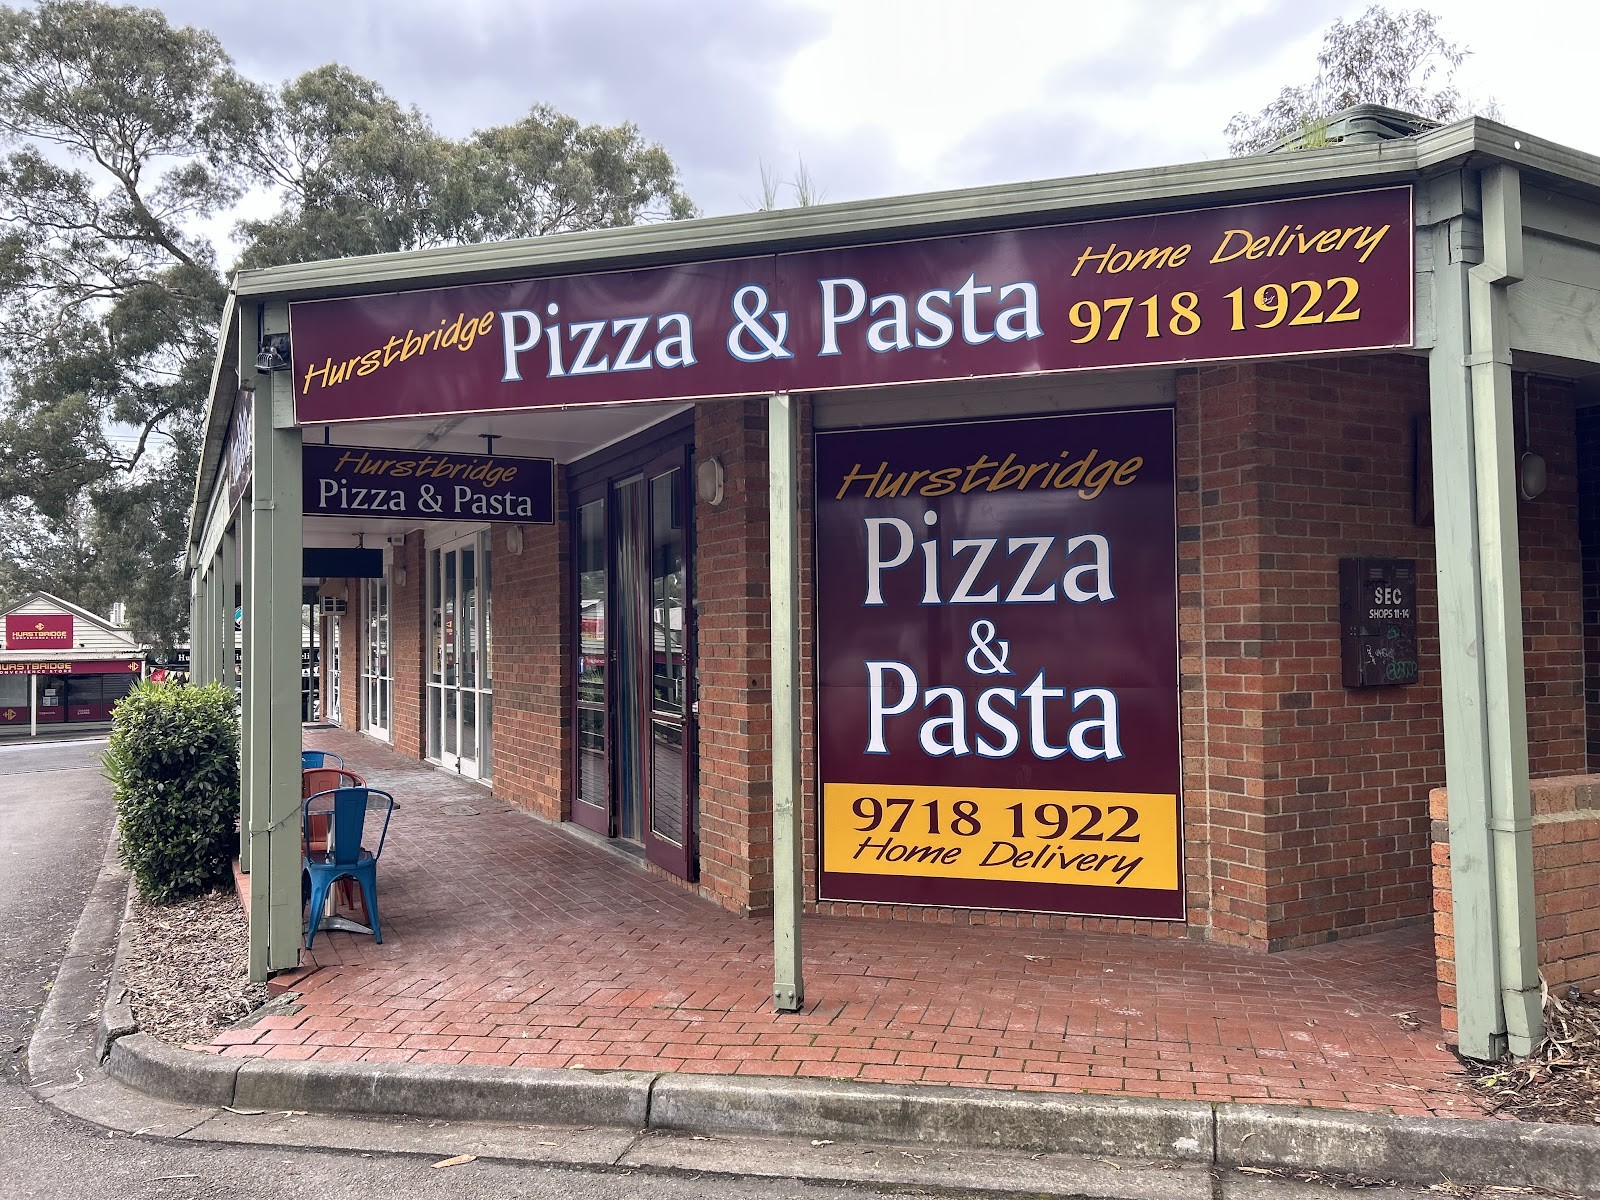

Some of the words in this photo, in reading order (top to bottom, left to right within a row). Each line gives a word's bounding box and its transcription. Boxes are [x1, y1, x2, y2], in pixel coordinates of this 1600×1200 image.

[1071, 242, 1192, 277] Home
[1210, 222, 1391, 264] Delivery
[303, 310, 495, 394] Hurstbridge
[501, 303, 697, 383] Pizza
[728, 284, 793, 363] &
[818, 273, 1043, 357] Pasta
[1069, 290, 1202, 344] 9718
[1223, 276, 1361, 332] 1922
[334, 451, 518, 487] Hurstbridge
[836, 449, 1144, 500] Hurstbridge
[318, 478, 407, 513] Pizza
[417, 483, 443, 513] &
[454, 486, 533, 517] Pasta
[863, 510, 1117, 606] Pizza
[1369, 609, 1392, 618] SHOPS
[1375, 587, 1402, 604] SEC
[0, 662, 71, 670] URSTBRIDGE
[966, 619, 1016, 676] &
[863, 660, 1126, 762] Pasta
[852, 797, 981, 836] 9718
[1006, 802, 1140, 843] 1922
[852, 836, 962, 866] Home
[979, 841, 1144, 885] Delivery
